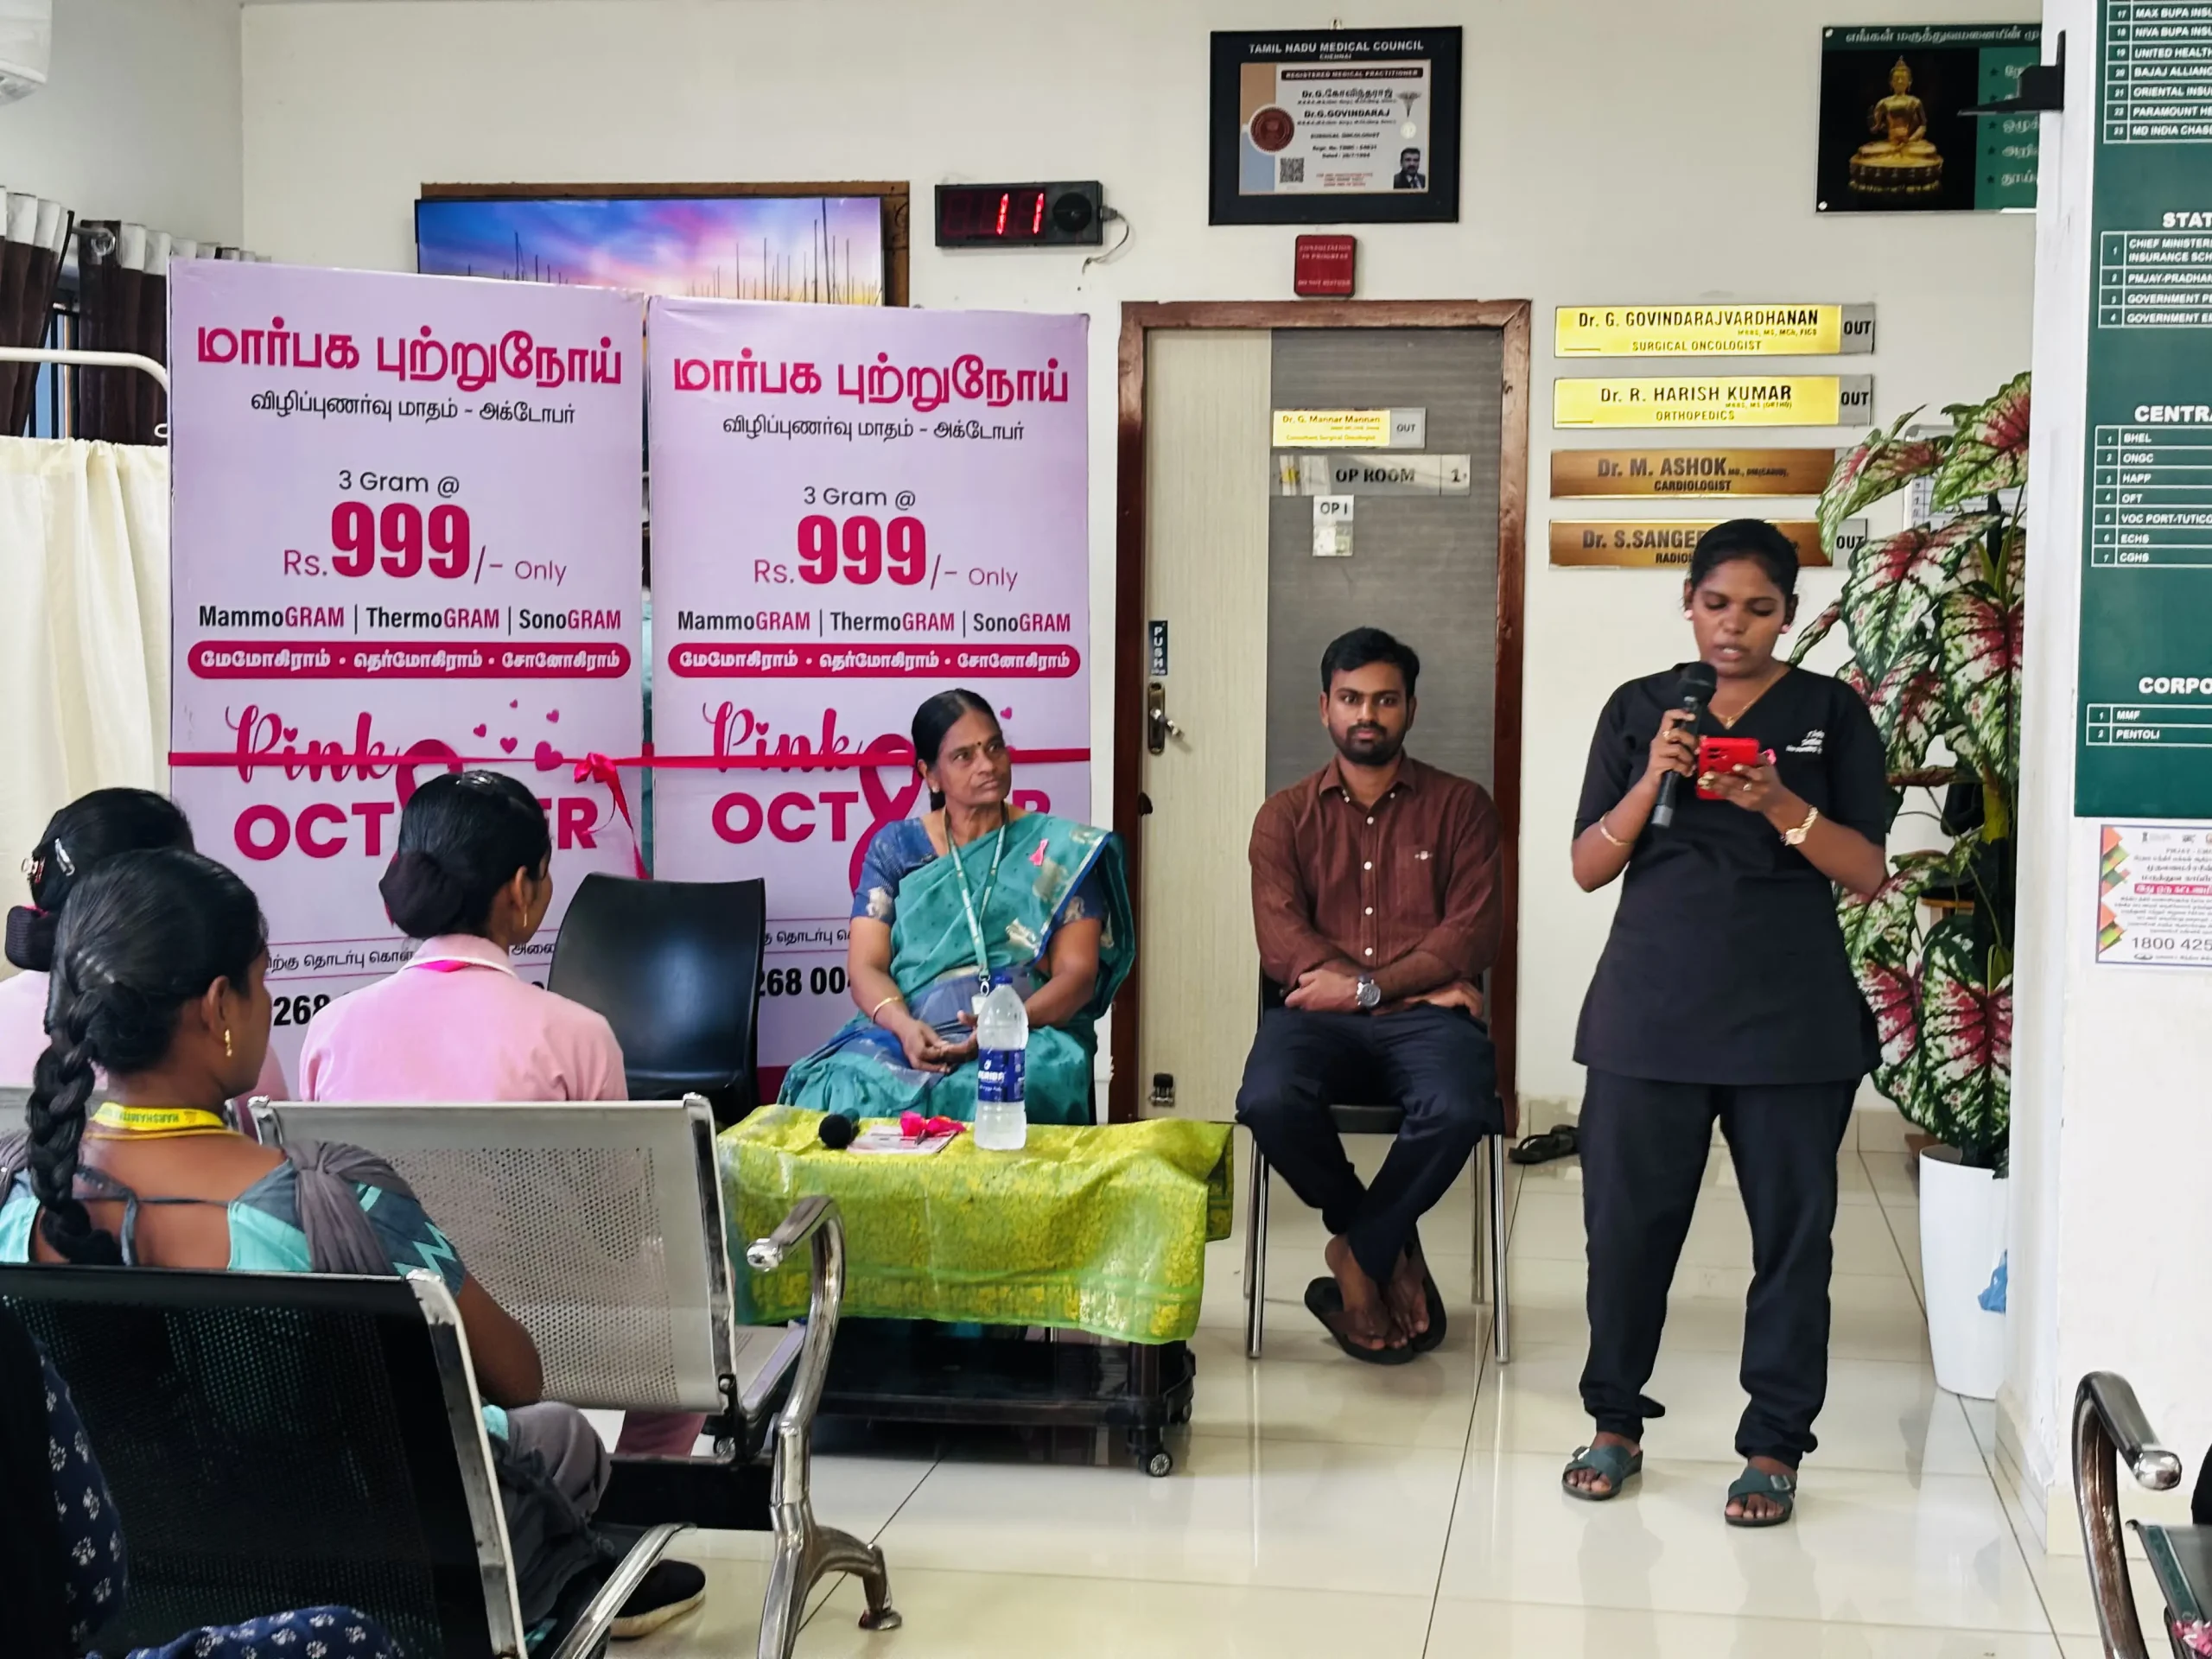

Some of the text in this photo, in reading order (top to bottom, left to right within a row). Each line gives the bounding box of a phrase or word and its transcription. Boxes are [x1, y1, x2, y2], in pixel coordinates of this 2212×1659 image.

[2136, 8, 2158, 18] MAX
[2161, 8, 2189, 17] BUPA
[2135, 28, 2159, 37] NIVA
[2161, 27, 2190, 36] BUPA
[1249, 41, 1424, 54] TAMIL NADU MEDICAL COUNCIL
[2134, 48, 2173, 58] UNITED
[2134, 67, 2168, 77] BAJAJ
[2133, 86, 2184, 97] ORIENTAL
[2187, 86, 2212, 96] INSU
[2133, 106, 2198, 117] PARAMOUNT
[2133, 125, 2149, 136] MD
[2151, 125, 2177, 136] INDIA
[2129, 238, 2159, 249] CHIEF
[2162, 238, 2212, 248] MINISTER
[2128, 252, 2189, 263] INSURANCE
[2127, 294, 2200, 304] GOVERNMENT
[1579, 309, 1818, 328] Dr. G. GOVINDARAJVARDHANAN
[2126, 313, 2199, 323] GOVERNMENT
[1843, 321, 1871, 335] OUT
[1632, 340, 1763, 352] SURGICAL ONCOLOGIST
[198, 316, 621, 391] மார்பக புற்றுநோய்
[674, 347, 1069, 411] மார்பக புற்றுநோய்
[1601, 385, 1792, 403] Dr. R. HARISH KUMAR
[1840, 391, 1869, 405] OUT
[251, 391, 575, 424] விழிப்புணர்வு மாதம் அக்டோபர்
[2134, 405, 2212, 423] CENTR
[1656, 410, 1735, 421] ORTHOPEDICS
[722, 415, 1025, 442] விழிப்புணர்வு மாதம் அக்டோபர்
[2124, 433, 2152, 443] BHEL
[2123, 453, 2154, 463] ONGC
[1598, 459, 1623, 476] Dr.
[1630, 458, 1654, 476] M.
[1660, 457, 1726, 476] ASHOK
[1336, 468, 1358, 482] OP
[1363, 468, 1415, 482] ROOM
[2122, 474, 2152, 484] HAPP
[339, 470, 460, 498] 3 Gram @
[1655, 480, 1732, 492] CARDIOLOGIST
[804, 486, 916, 511] 3 Gram @
[1319, 502, 1339, 514] OP
[2121, 513, 2144, 524] VOC
[1583, 531, 1607, 549] Dr.
[1836, 535, 1864, 550] OUT
[2120, 534, 2150, 544] ECHS
[2120, 552, 2150, 563] CGHS
[515, 562, 567, 587] Only
[969, 567, 1018, 592] Only
[199, 605, 622, 630] MammoGRAM ThermoGRAM SonoGRAM
[677, 611, 1071, 633] MammoGRAM ThermoGRAM SonoGRAM
[1154, 626, 1164, 668] PUSH
[200, 648, 332, 670] மேமோகிராம்
[679, 649, 799, 670] மேமோகிராம்
[2117, 710, 2140, 721] MMF
[225, 704, 401, 784] Pink
[702, 701, 863, 773] Pink
[2133, 937, 2175, 950] 1800
[810, 966, 851, 995] 00
